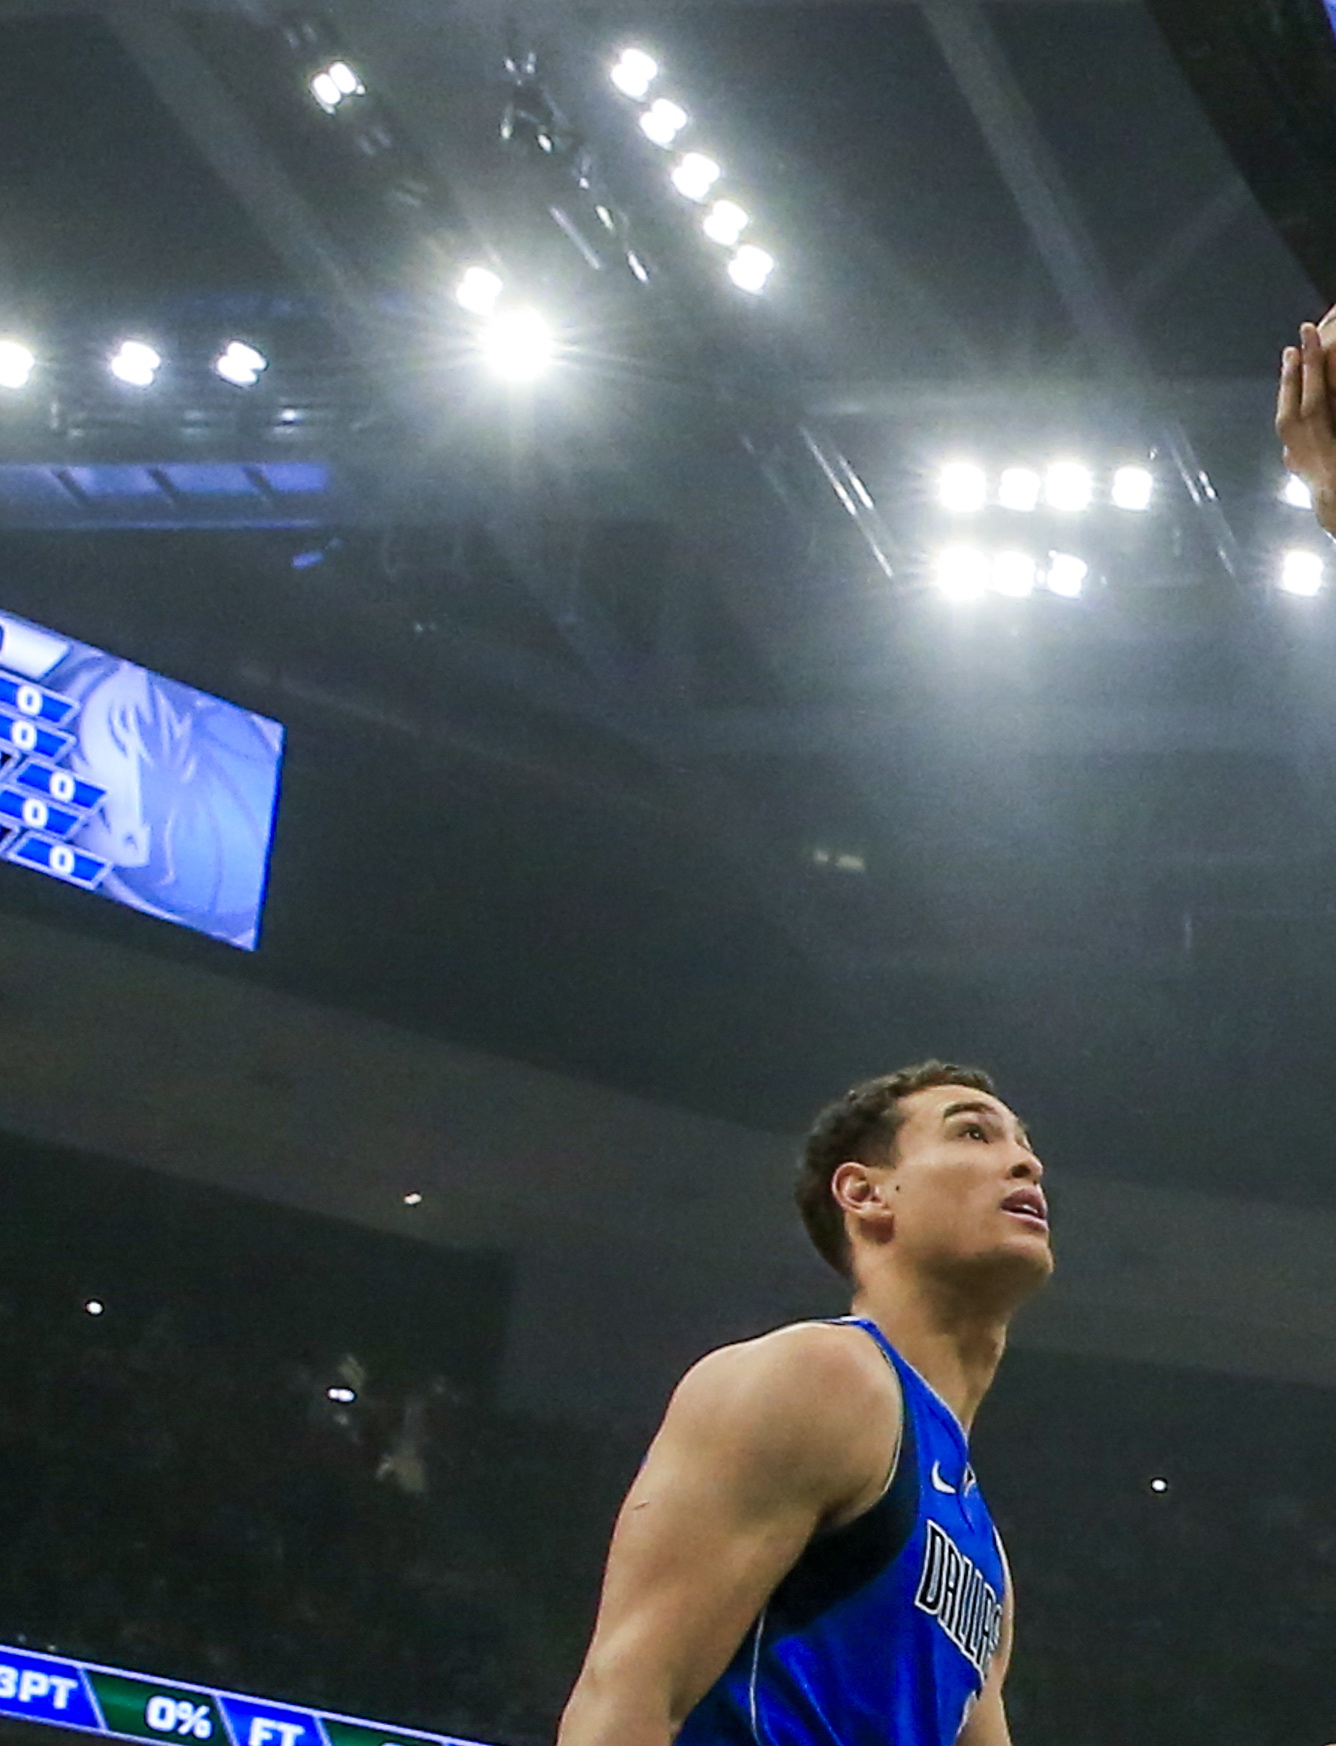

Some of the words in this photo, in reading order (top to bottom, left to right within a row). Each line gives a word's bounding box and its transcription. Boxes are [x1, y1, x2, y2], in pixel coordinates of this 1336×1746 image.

[16, 684, 43, 714] 0
[10, 719, 37, 749] 0
[50, 771, 76, 802] 0
[22, 797, 48, 828] 0
[49, 845, 75, 875] 0
[915, 1519, 1003, 1685] DALLAS
[0, 1664, 78, 1710] 3PT
[146, 1695, 213, 1740] 0%
